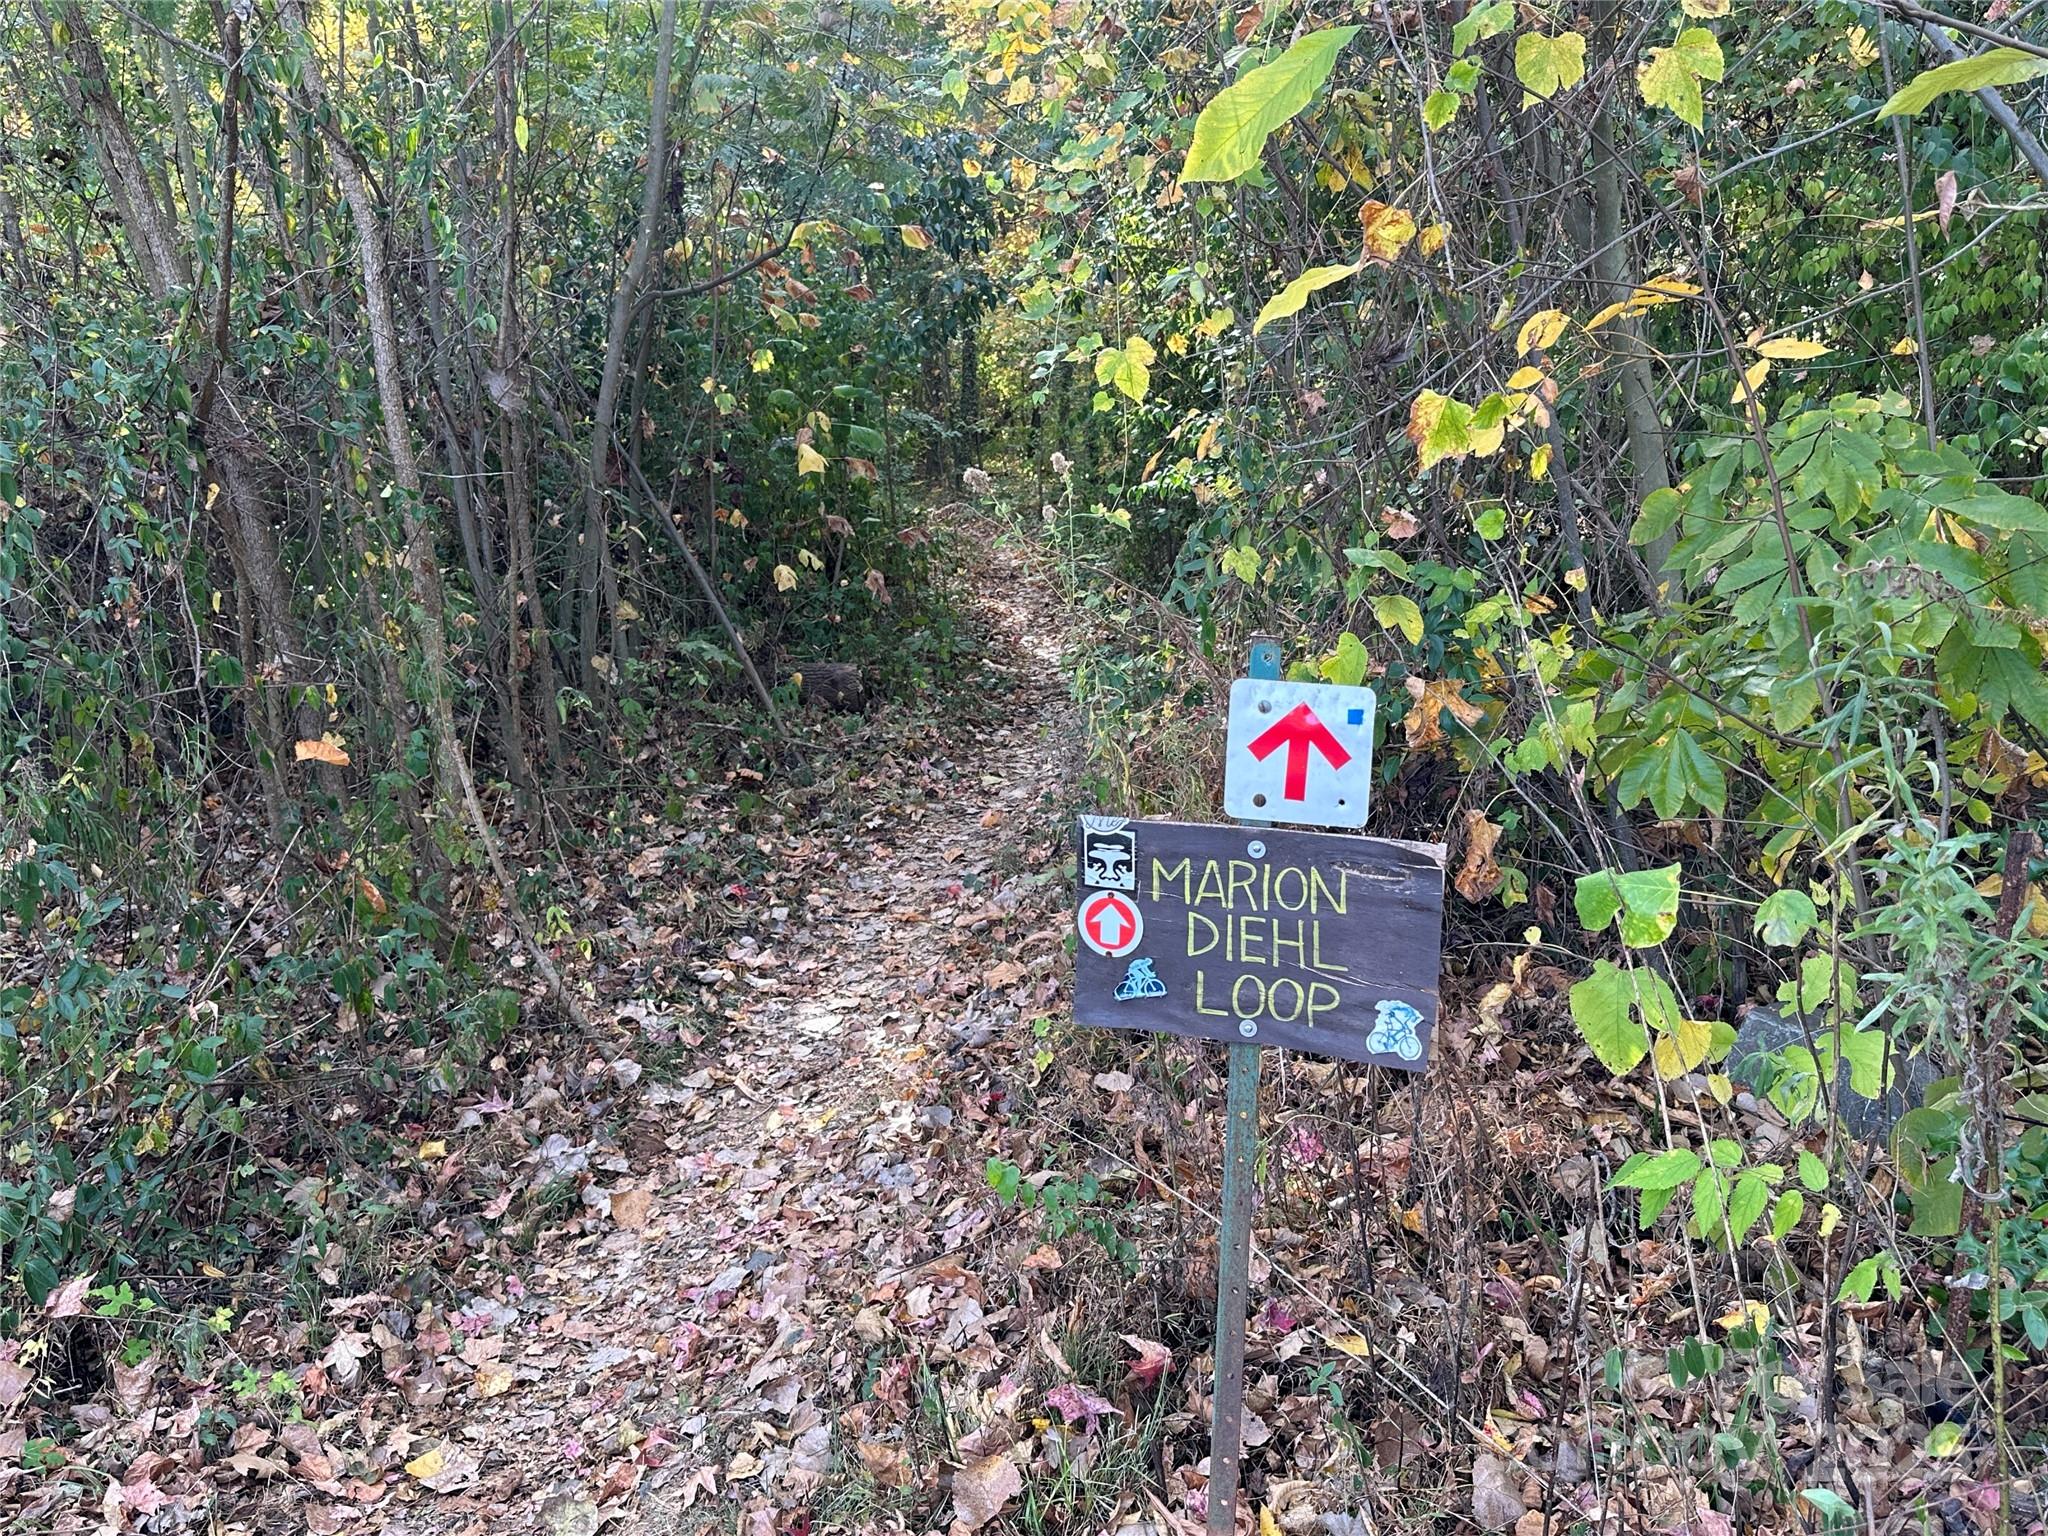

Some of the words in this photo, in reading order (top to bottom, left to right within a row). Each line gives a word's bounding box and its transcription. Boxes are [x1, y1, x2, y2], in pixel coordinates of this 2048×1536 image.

[1152, 857, 1347, 915] MARION
[1187, 911, 1349, 972] DIEHL
[1195, 970, 1341, 1028] LOOP
